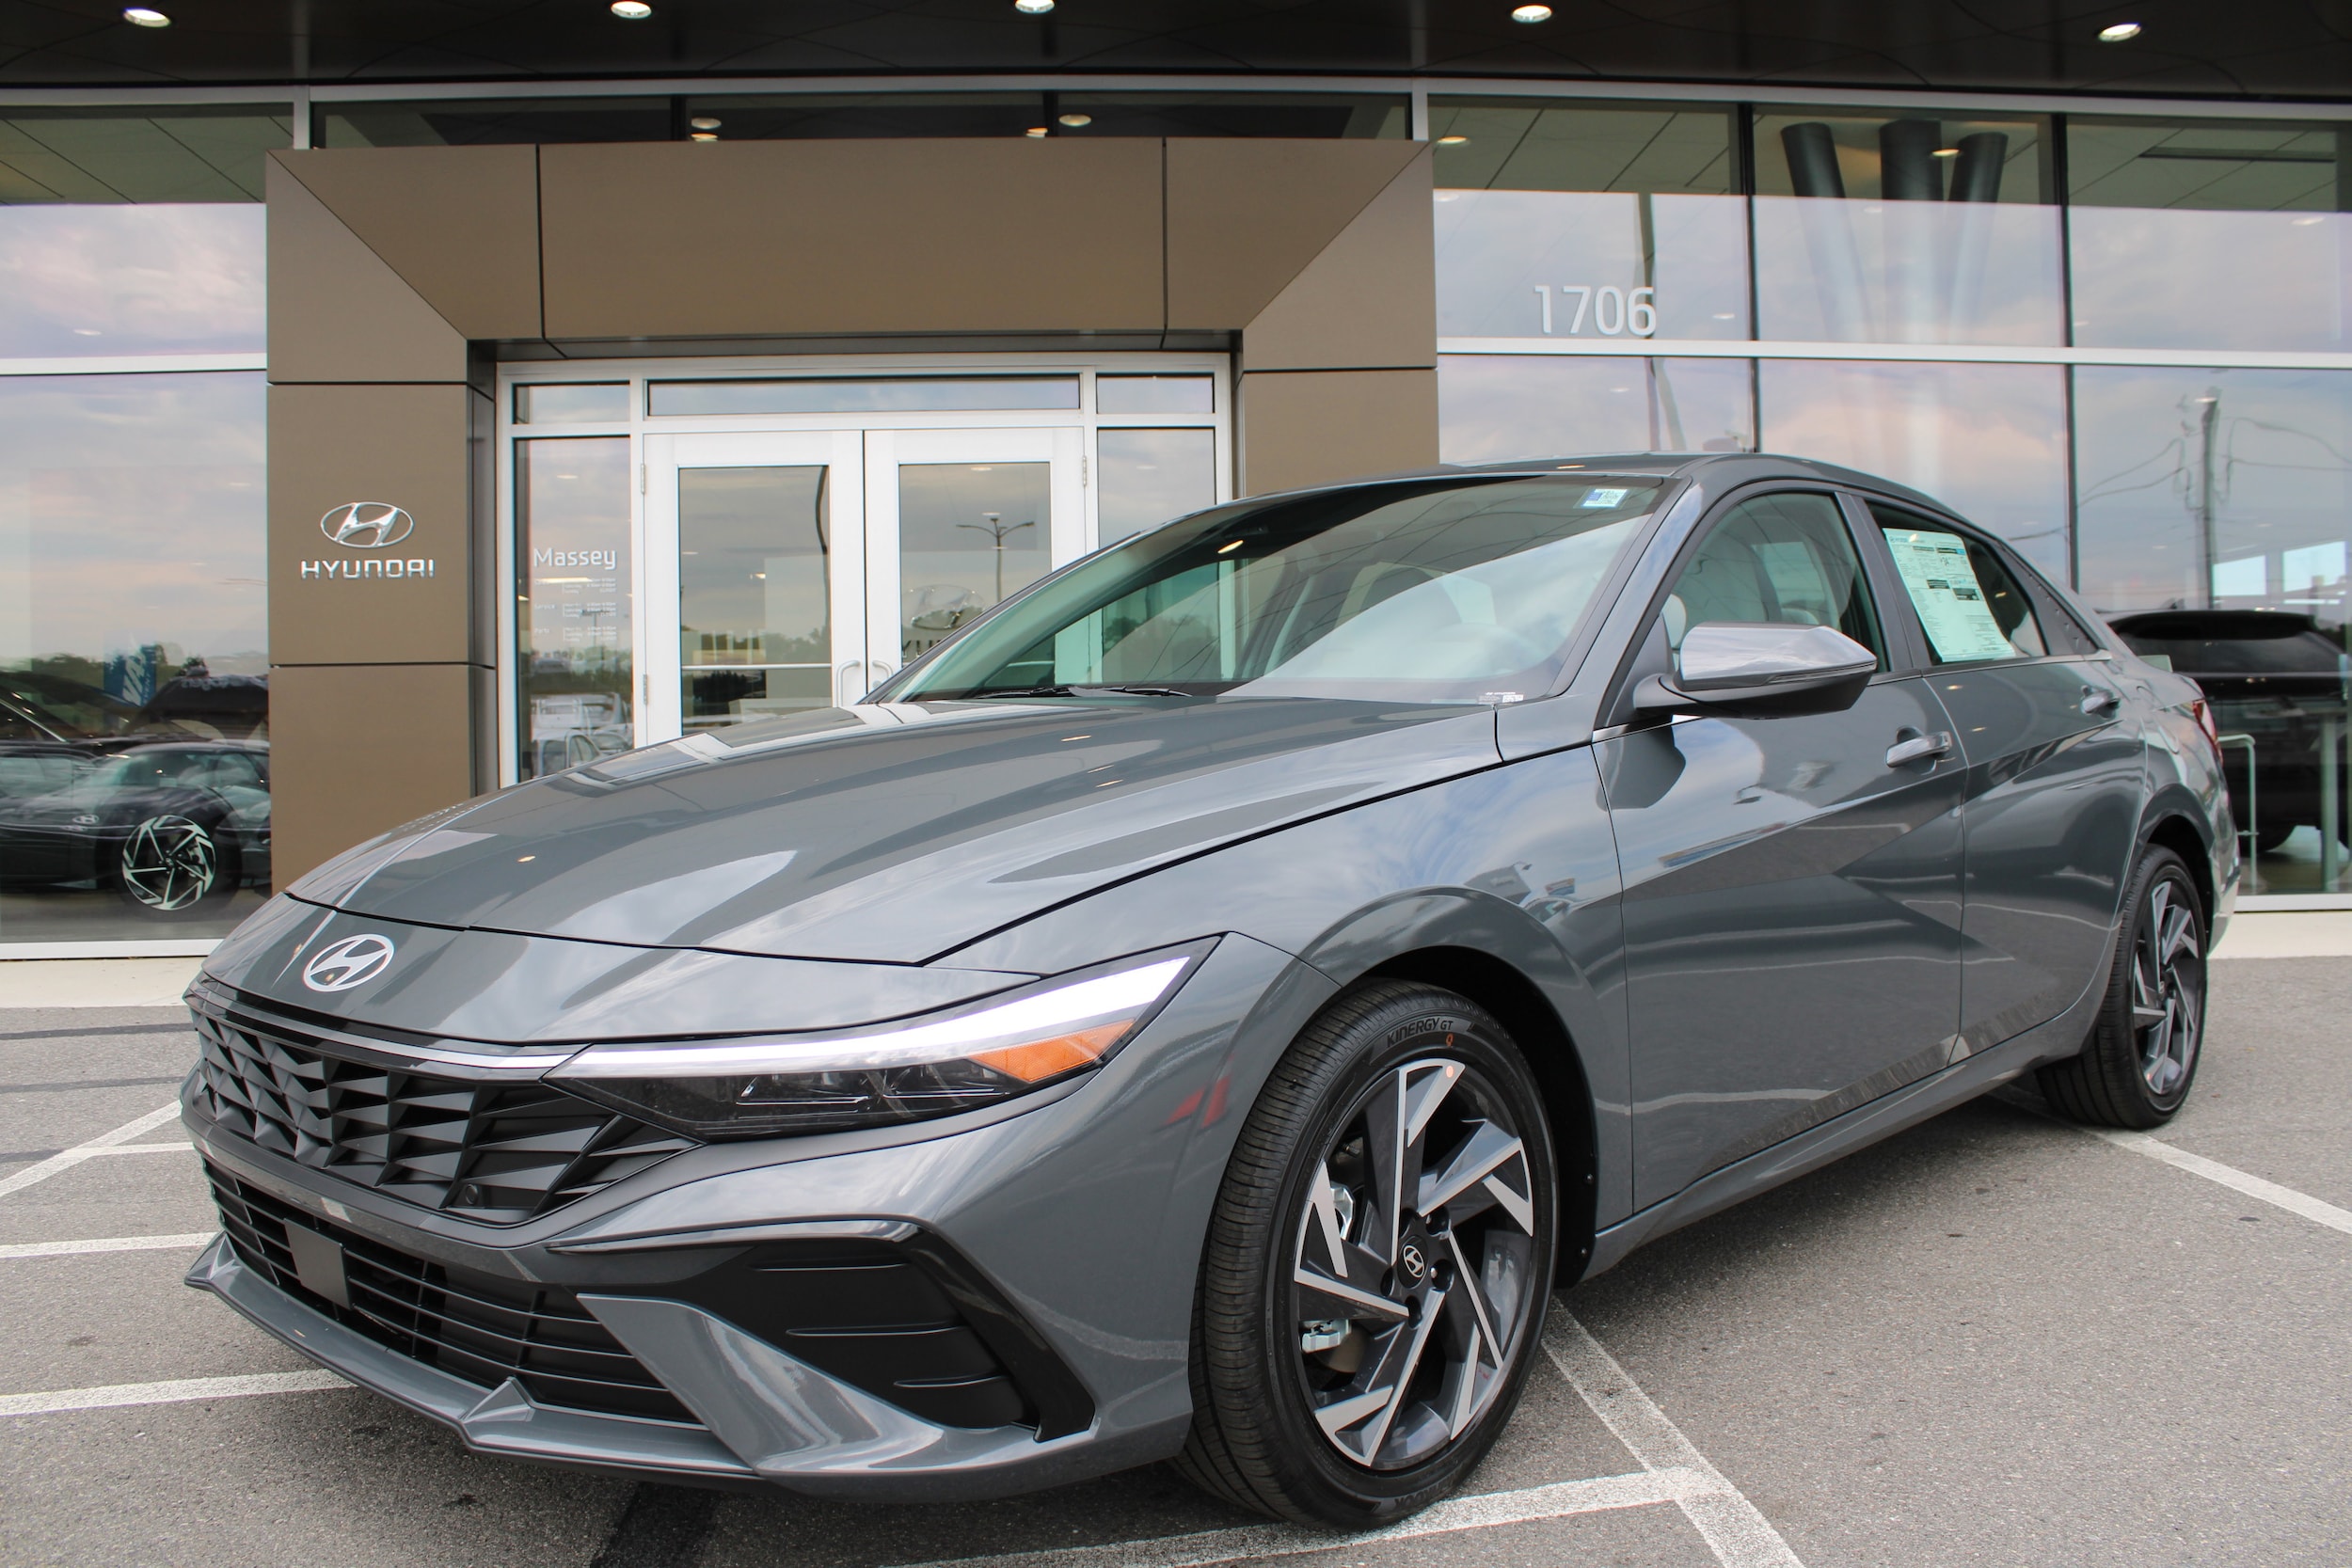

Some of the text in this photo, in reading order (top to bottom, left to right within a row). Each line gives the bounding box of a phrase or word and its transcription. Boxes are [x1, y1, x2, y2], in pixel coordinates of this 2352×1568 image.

[1534, 285, 1657, 336] 1706
[300, 559, 436, 579] HYUNDAI
[532, 547, 616, 569] Massey
[1387, 1018, 1454, 1047] KINERGY GT
